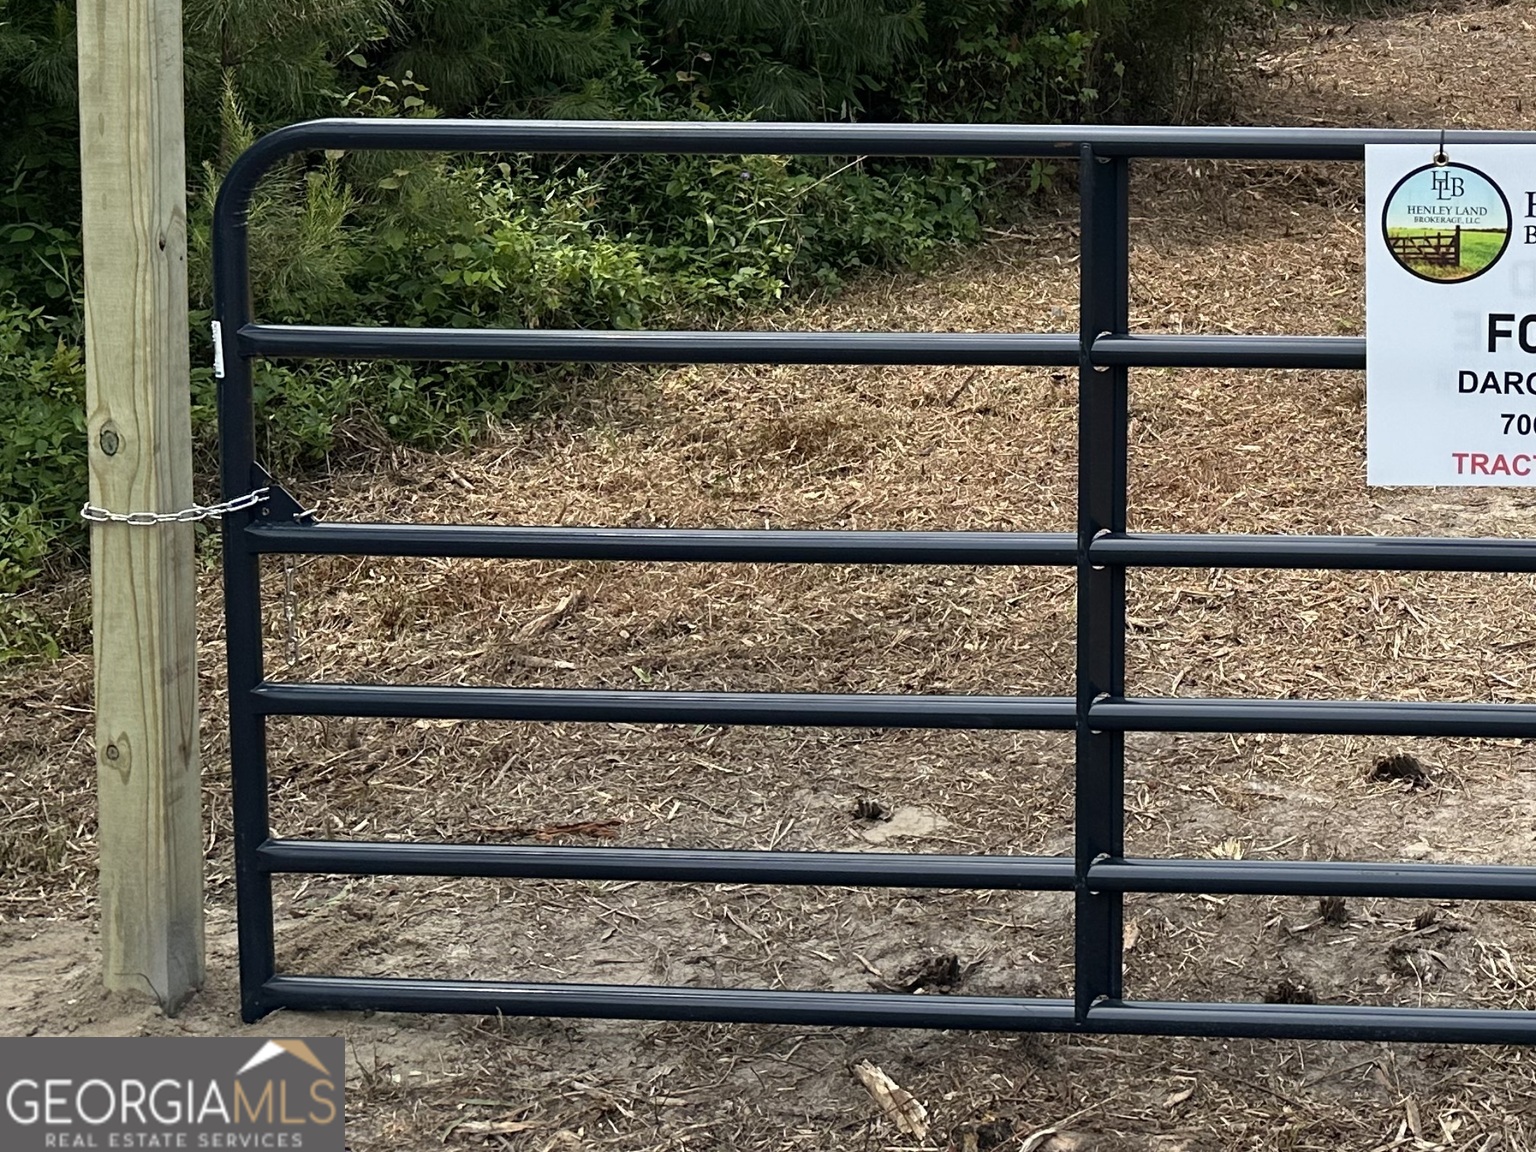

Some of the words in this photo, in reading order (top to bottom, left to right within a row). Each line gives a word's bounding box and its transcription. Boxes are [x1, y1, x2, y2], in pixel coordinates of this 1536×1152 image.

[1407, 205, 1452, 216] HENLEY
[1455, 206, 1488, 217] LAND
[1414, 216, 1464, 224] BROKERAGE,
[1465, 216, 1481, 224] LLC
